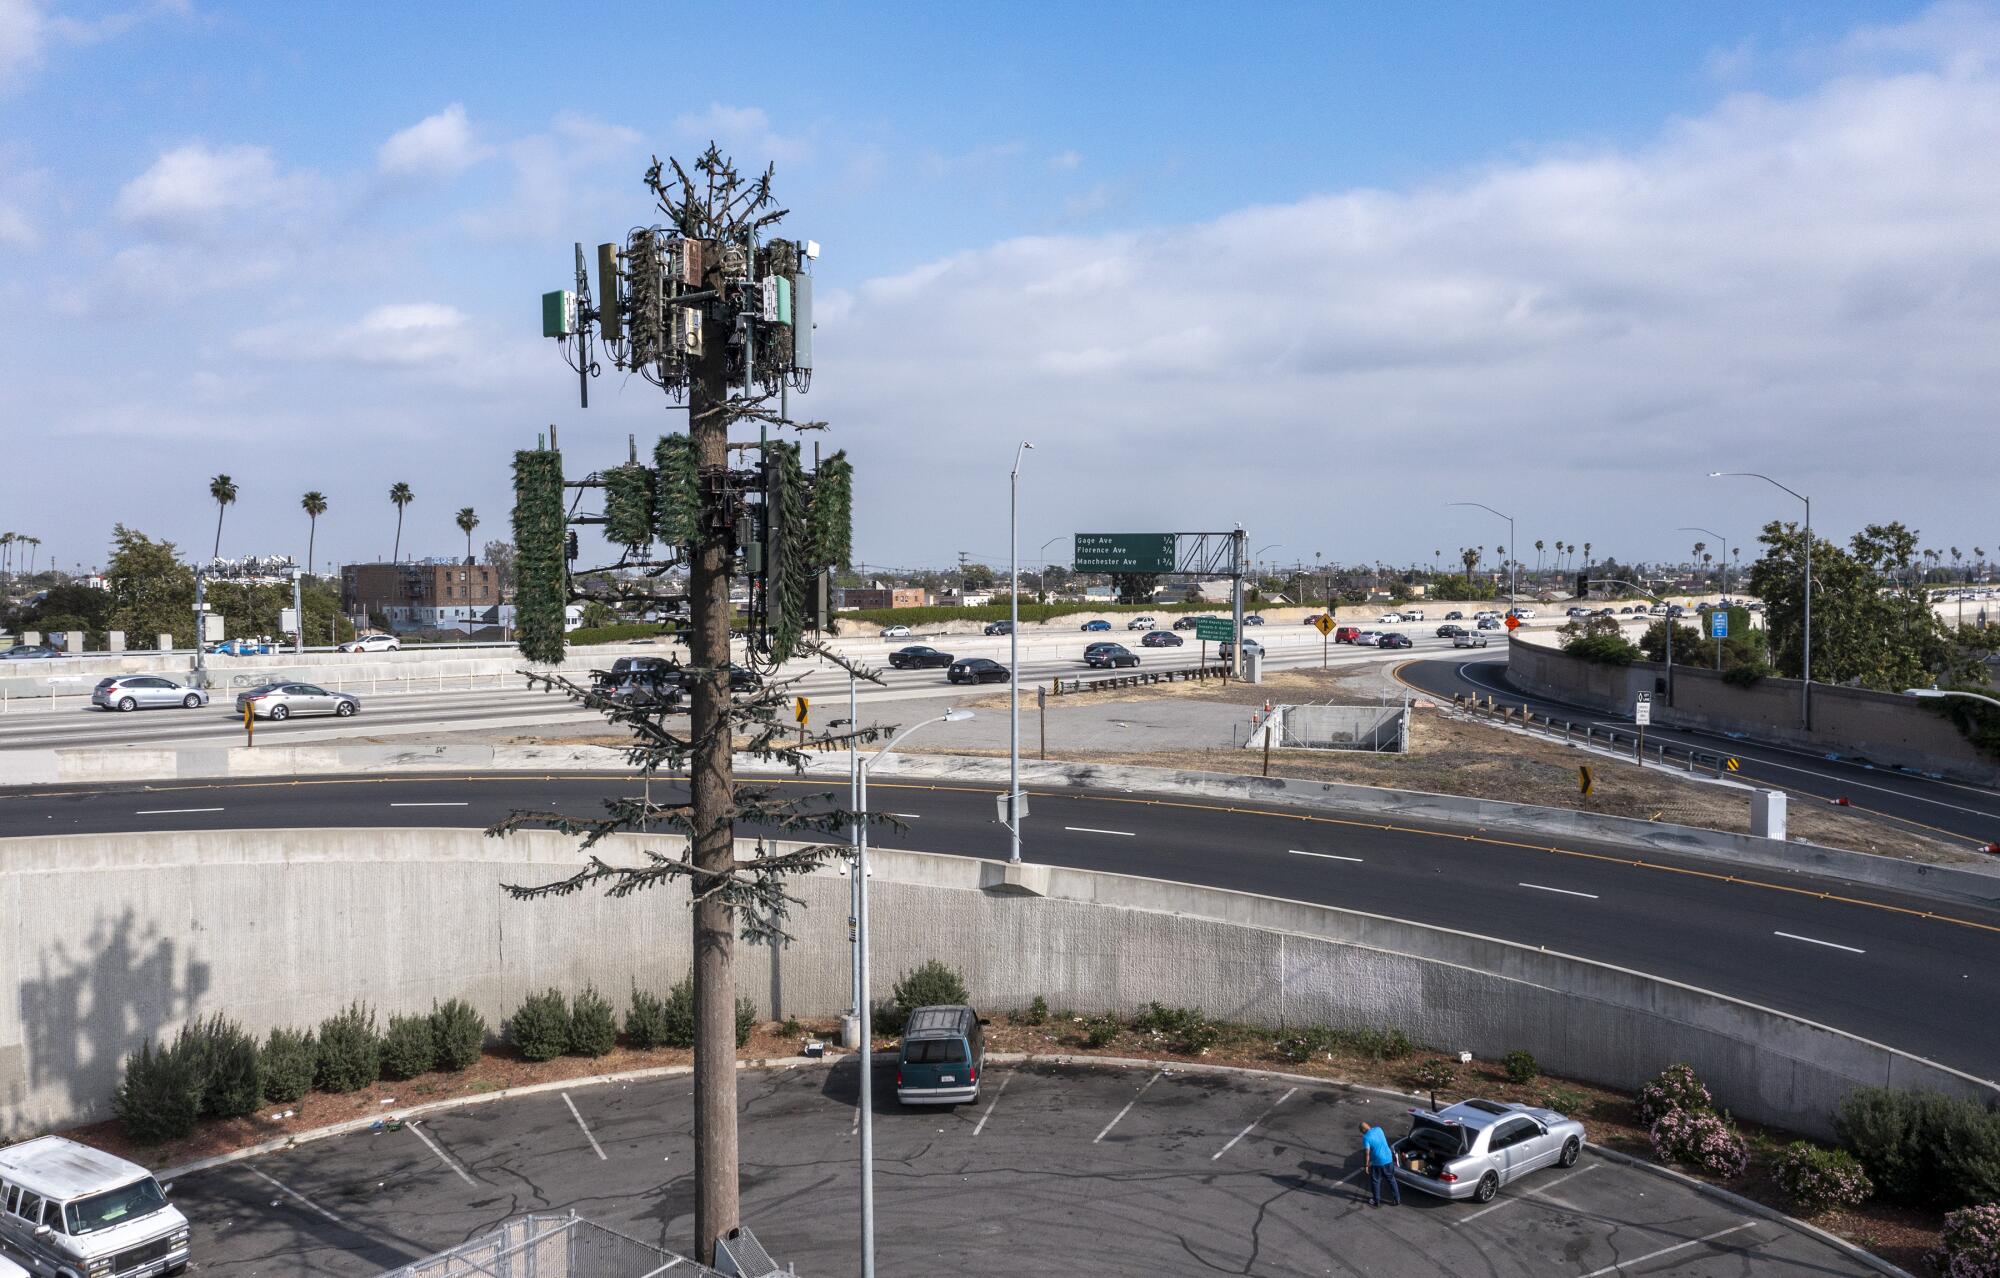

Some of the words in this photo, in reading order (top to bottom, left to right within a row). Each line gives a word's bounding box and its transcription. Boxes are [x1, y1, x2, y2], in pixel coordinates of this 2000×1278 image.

[1077, 537, 1095, 545] Gage
[1077, 546, 1109, 554] Florence
[1112, 546, 1127, 554] Ave
